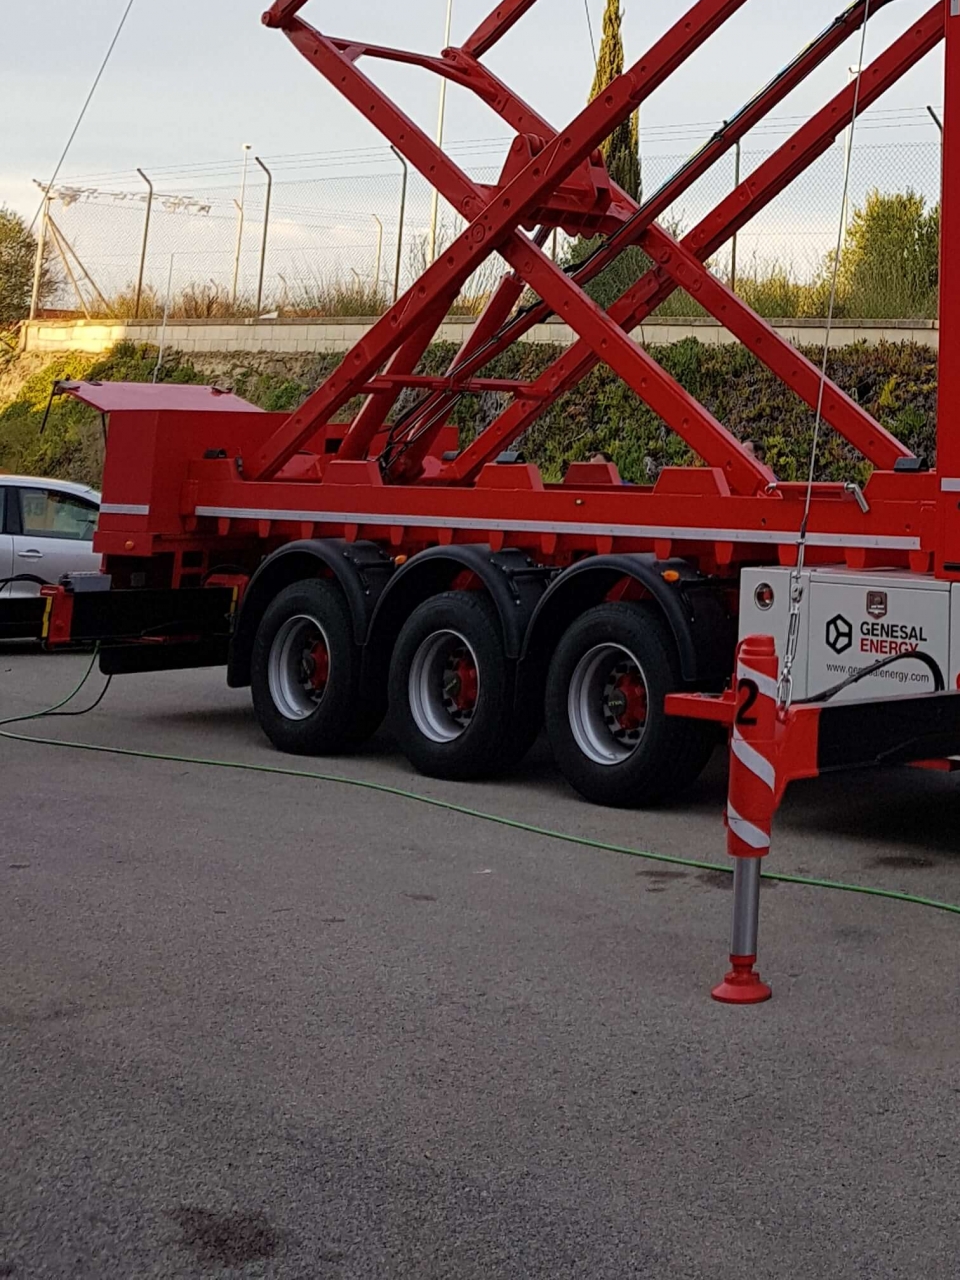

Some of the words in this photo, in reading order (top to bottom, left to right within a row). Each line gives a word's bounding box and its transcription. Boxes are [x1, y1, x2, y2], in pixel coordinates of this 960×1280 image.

[860, 621, 927, 642] GENESAL
[860, 638, 919, 656] ENERGY
[826, 663, 929, 683] www.gealenergy.com
[734, 677, 760, 726] 2
